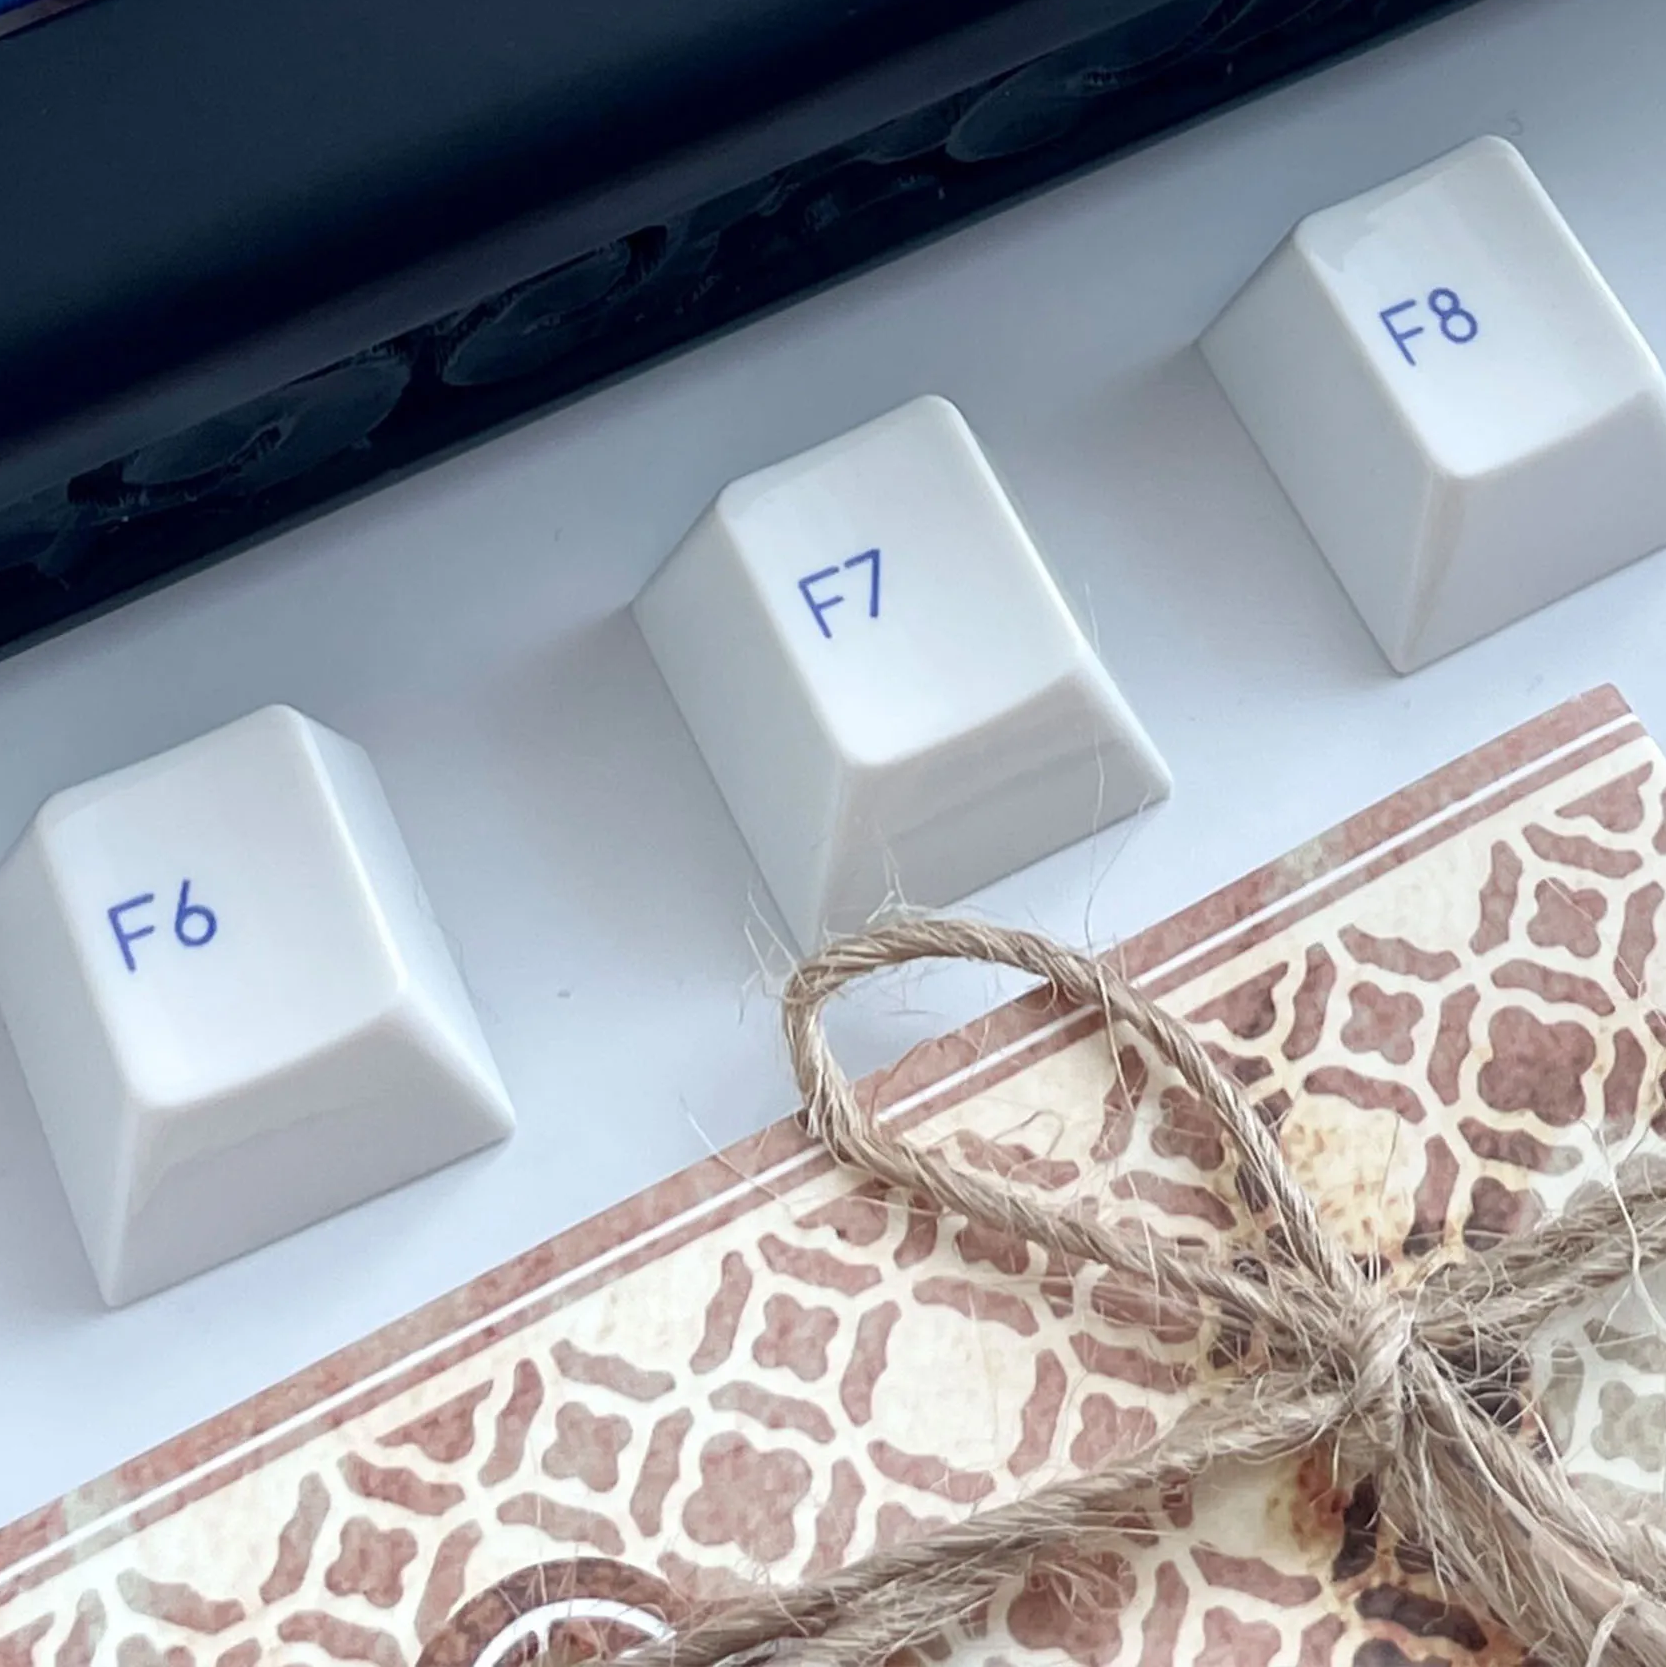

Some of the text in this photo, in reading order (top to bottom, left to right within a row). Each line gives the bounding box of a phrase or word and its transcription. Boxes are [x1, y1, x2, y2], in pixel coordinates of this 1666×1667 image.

[1379, 288, 1480, 364] F8
[797, 548, 882, 636] F7
[108, 880, 218, 971] F6
